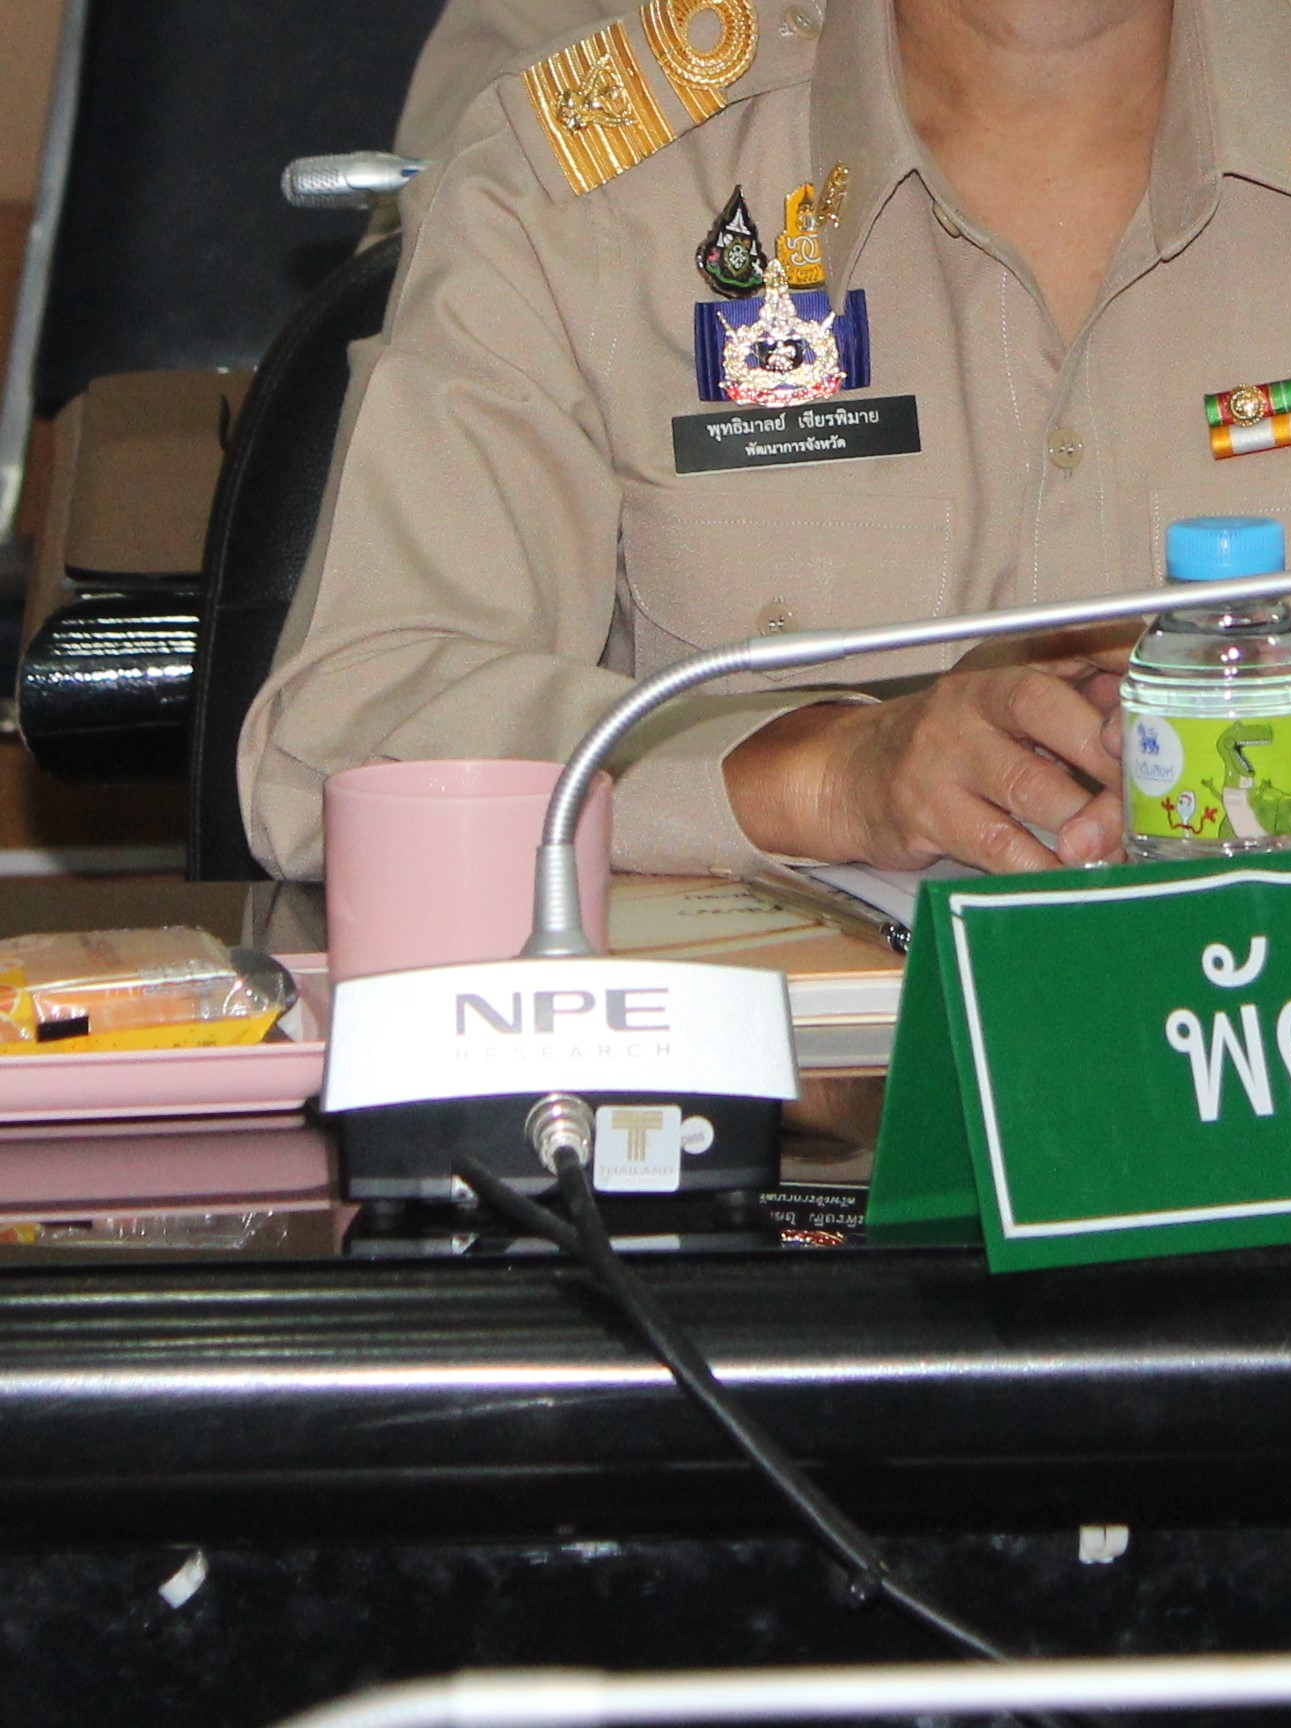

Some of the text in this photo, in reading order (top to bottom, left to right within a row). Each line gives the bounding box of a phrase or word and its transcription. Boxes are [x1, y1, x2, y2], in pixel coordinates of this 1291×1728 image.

[744, 434, 847, 457] พัฒนาการจังหวัด
[455, 987, 671, 1036] NPE
[456, 1043, 671, 1061] RESEARCH
